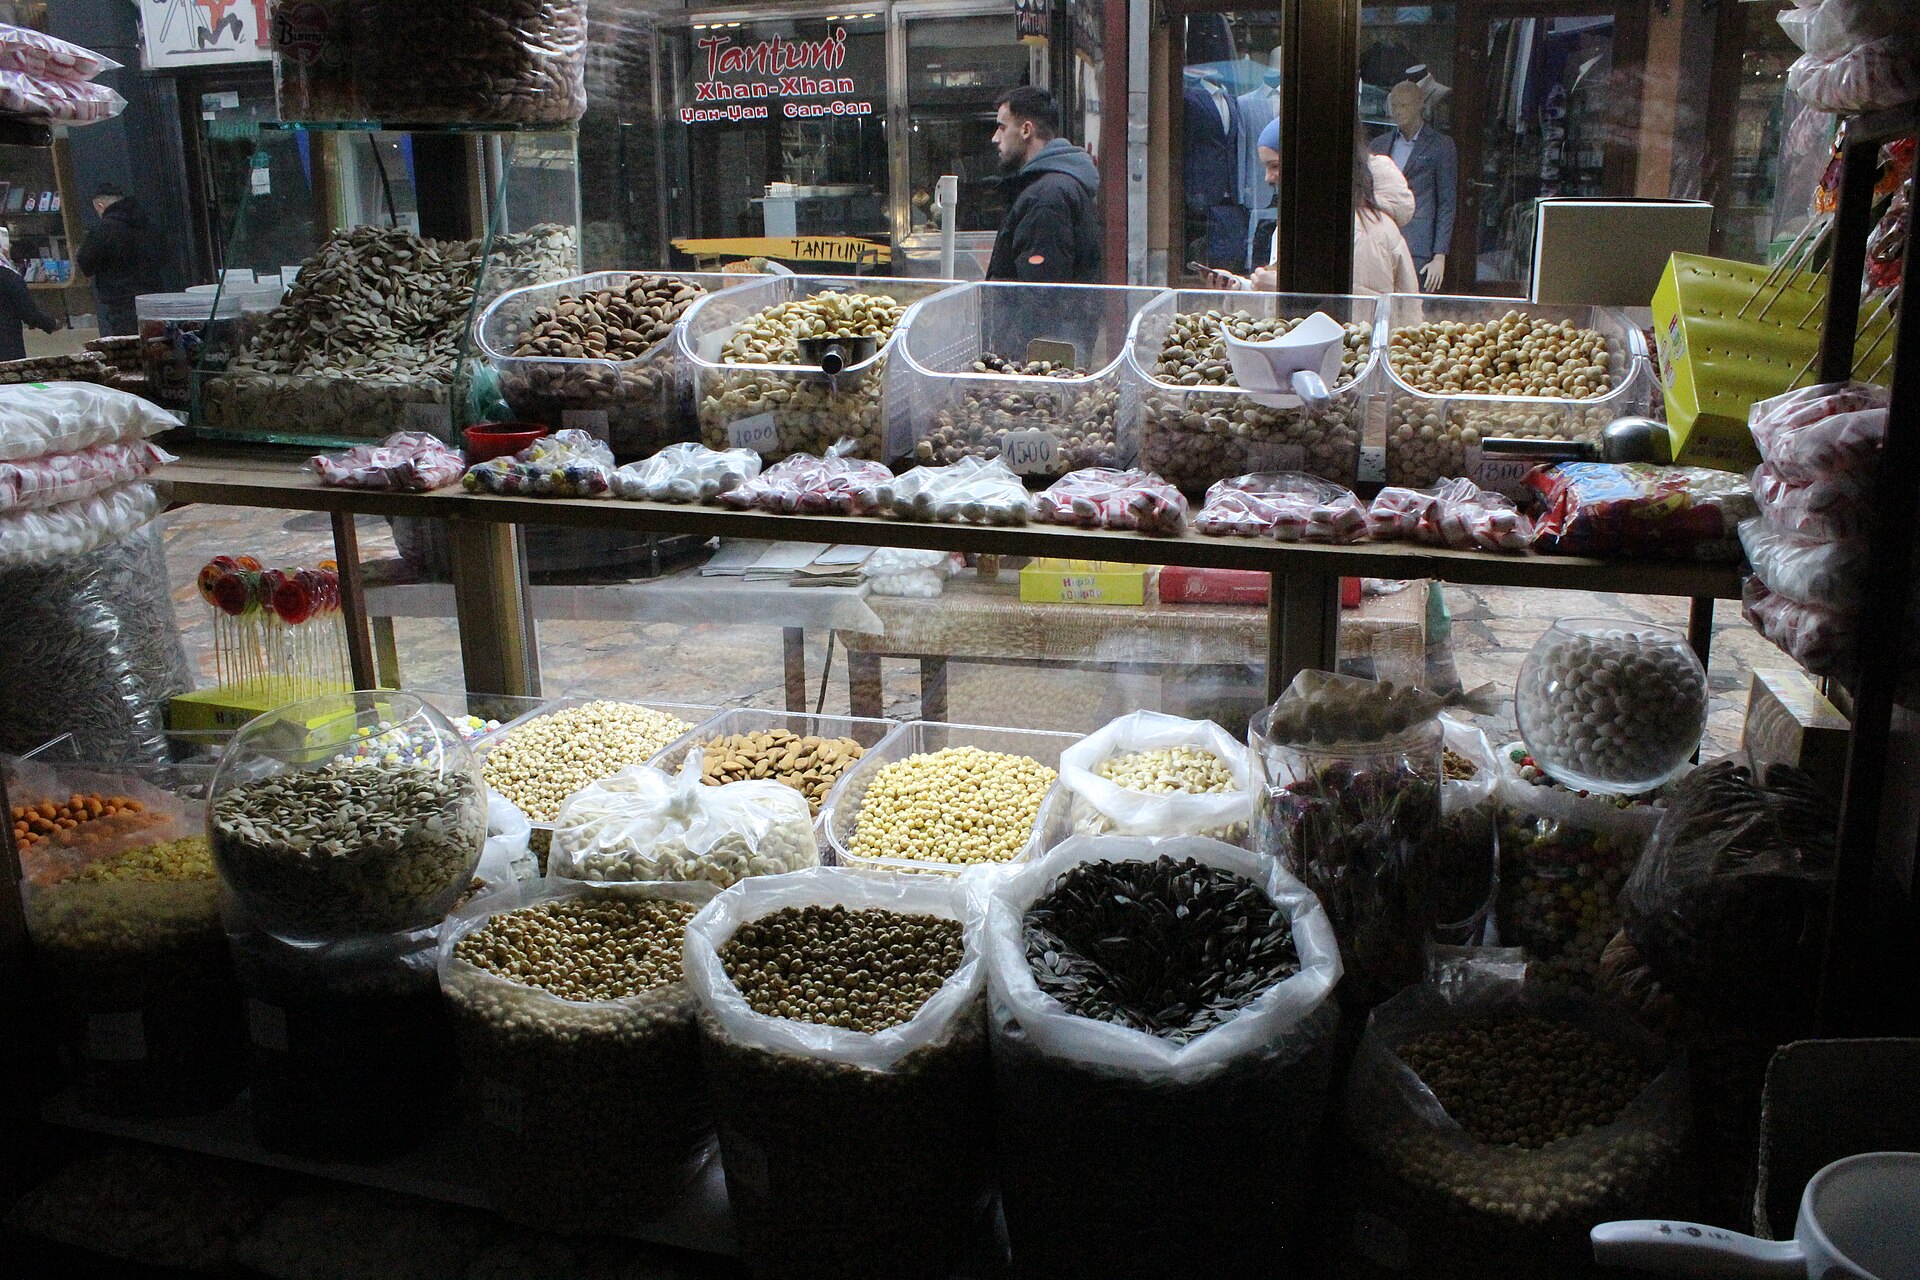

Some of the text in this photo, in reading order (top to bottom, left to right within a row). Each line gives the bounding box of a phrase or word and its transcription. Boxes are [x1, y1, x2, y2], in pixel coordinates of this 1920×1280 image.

[698, 27, 847, 81] Tantuni
[695, 77, 855, 102] Xhan-Xhan
[783, 101, 873, 119] Can-Can
[791, 239, 865, 262] TANTUNI
[736, 426, 773, 448] 1000
[1007, 440, 1050, 466] 1500
[1474, 462, 1525, 482] 1800
